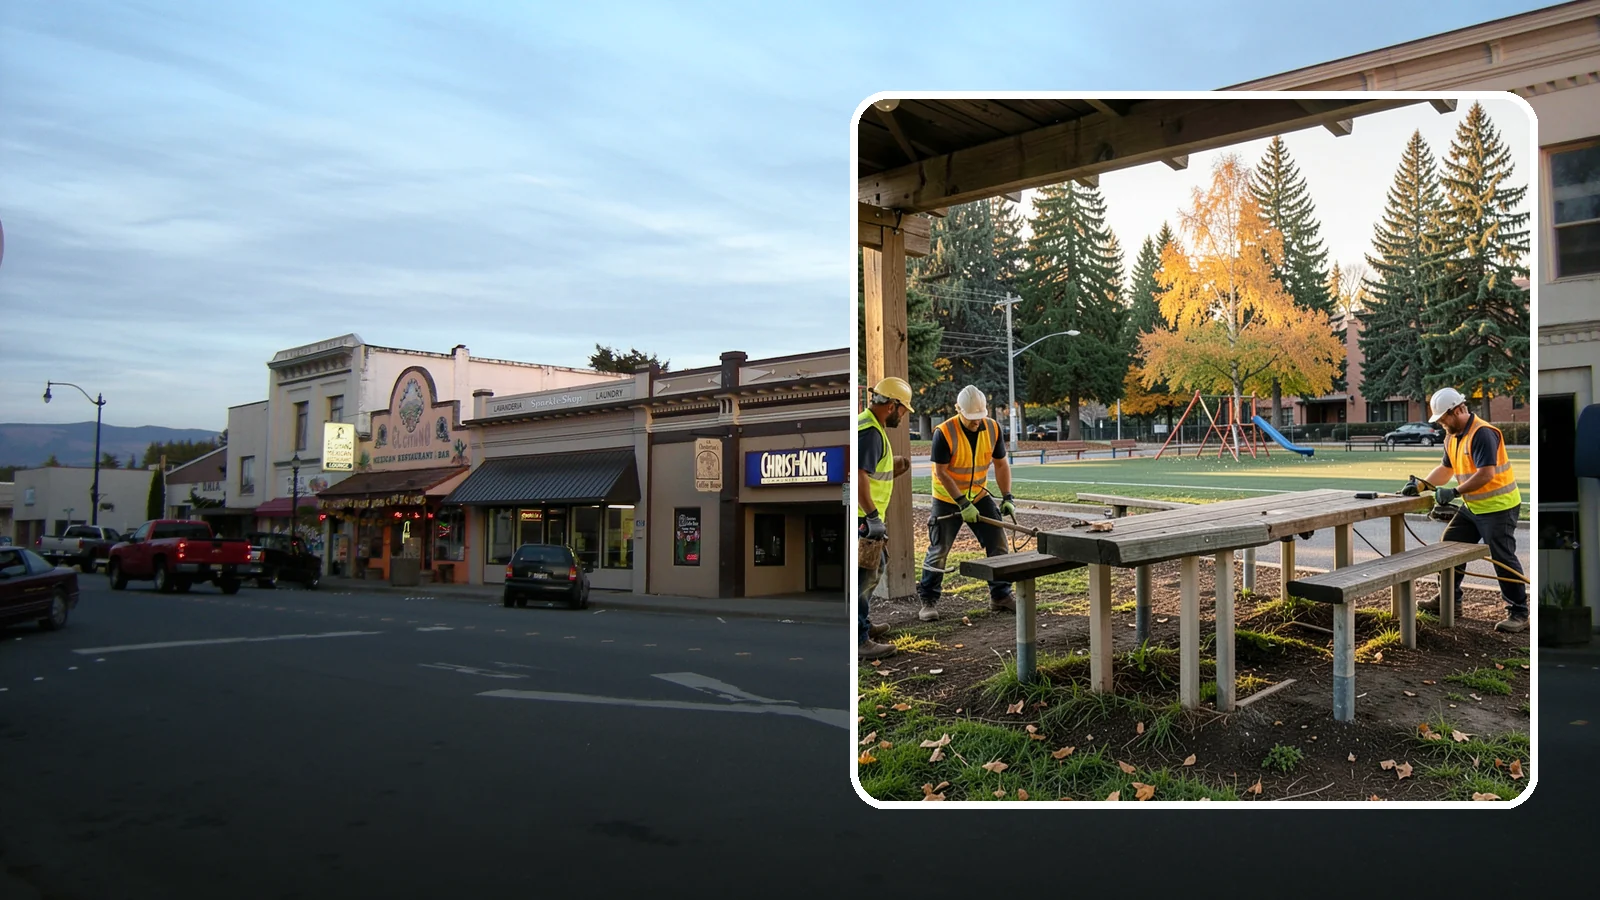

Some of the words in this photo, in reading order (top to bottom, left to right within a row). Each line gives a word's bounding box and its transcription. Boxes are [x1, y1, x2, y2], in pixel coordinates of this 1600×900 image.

[530, 395, 561, 409] Sparkle
[561, 393, 582, 405] Shop
[595, 389, 624, 400] LAUNDRY
[493, 401, 523, 413] LAVANDERIA
[372, 454, 396, 464] MEXICAN
[397, 451, 434, 462] RESTAURANT
[438, 450, 450, 459] BAR
[761, 452, 797, 478] CHRIST
[799, 450, 827, 476] KING
